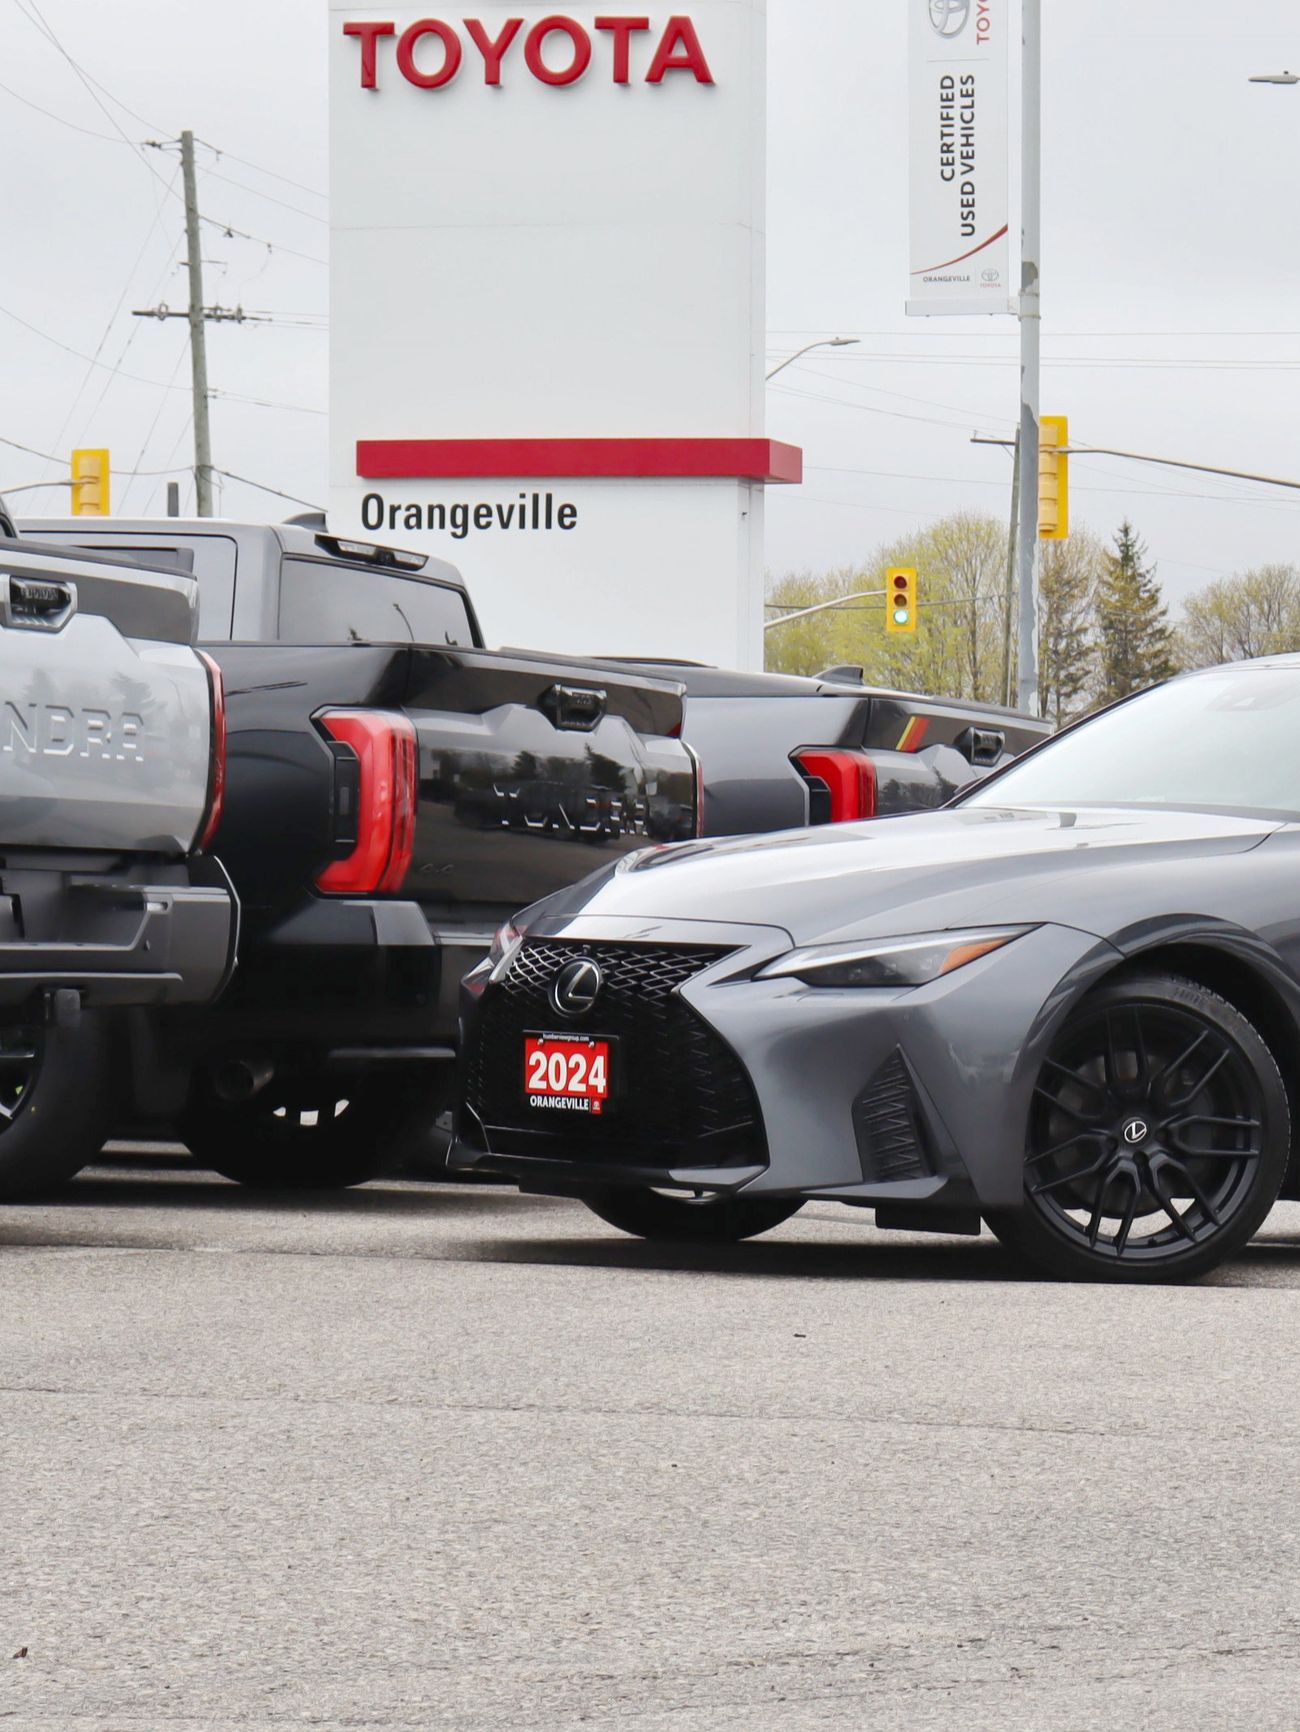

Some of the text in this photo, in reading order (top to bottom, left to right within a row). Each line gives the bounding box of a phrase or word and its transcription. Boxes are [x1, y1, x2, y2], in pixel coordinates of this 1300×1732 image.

[976, 0, 990, 45] TOY
[343, 15, 714, 89] TOYOTA
[940, 75, 955, 182] CERTIFIED
[960, 74, 976, 237] USED VEHICLES
[923, 275, 970, 283] ORANGEVILLE
[361, 493, 578, 538] Orangeville
[529, 1051, 606, 1093] 2024
[530, 1095, 589, 1110] ORANGEVILLE
